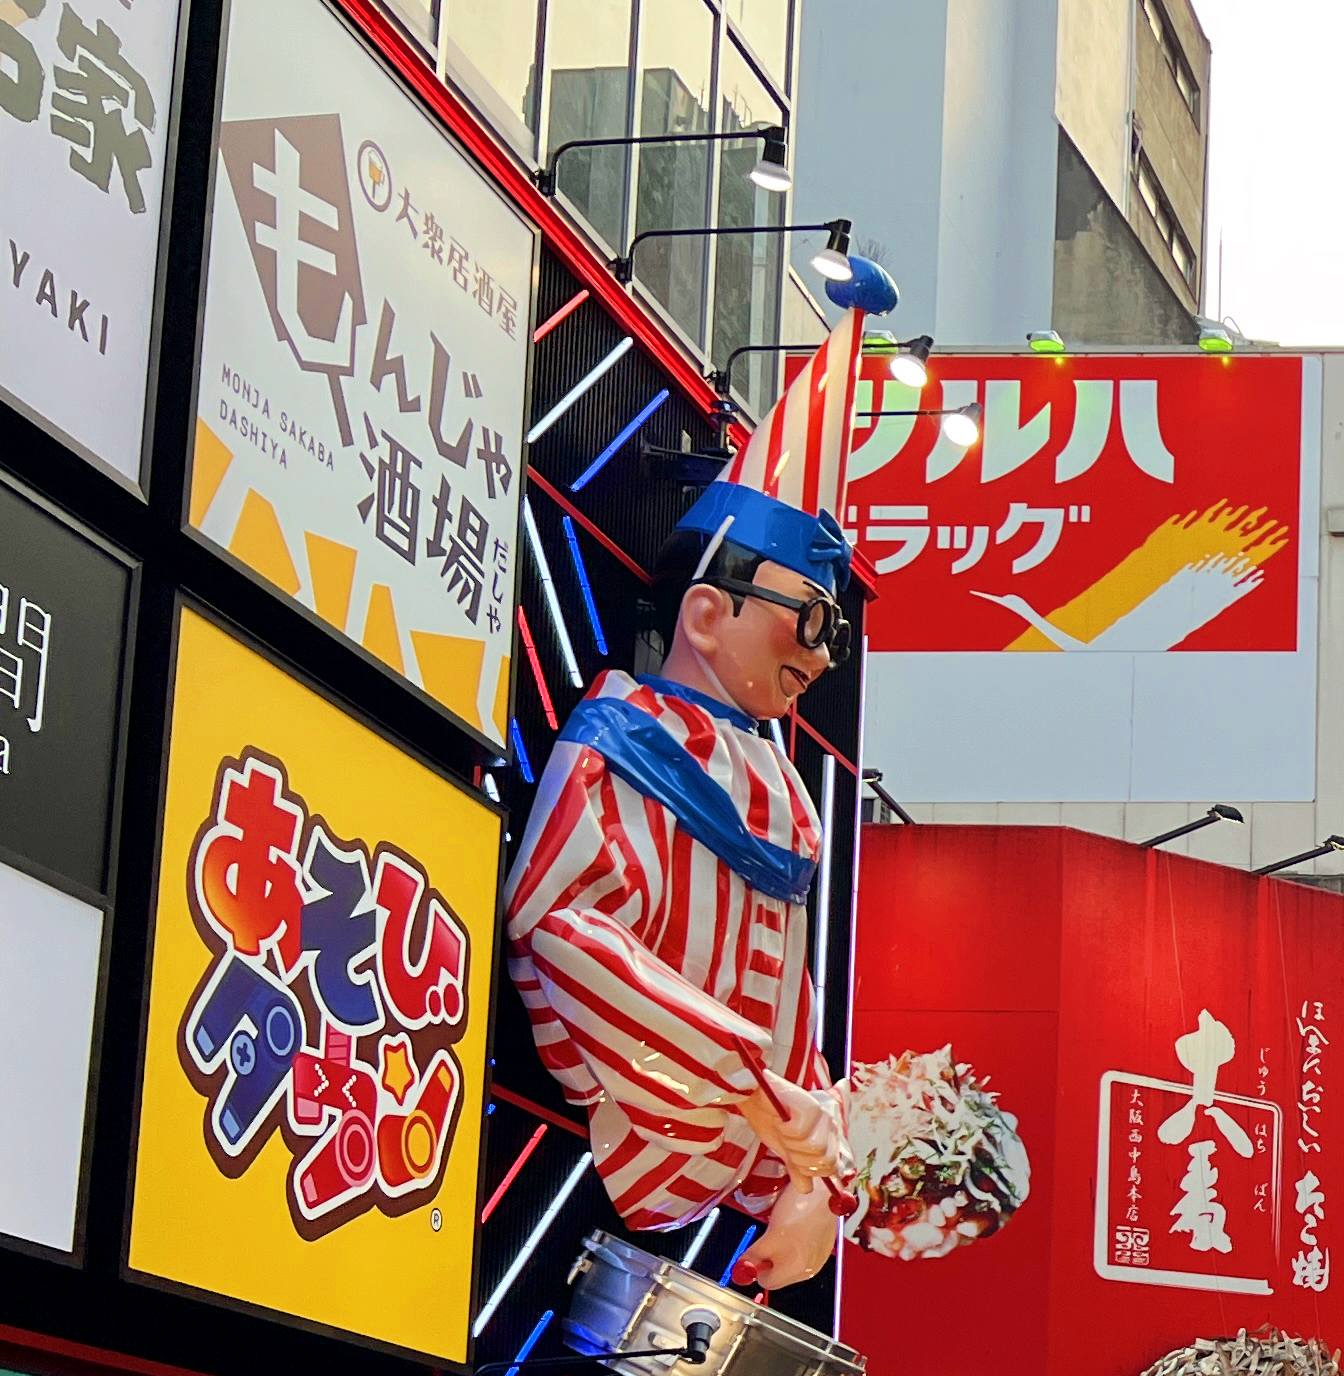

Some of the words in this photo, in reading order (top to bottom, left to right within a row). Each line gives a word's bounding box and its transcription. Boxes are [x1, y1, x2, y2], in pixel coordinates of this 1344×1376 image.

[252, 128, 513, 500] もんじゃ
[396, 186, 518, 342] 大衆居酒屋
[219, 398, 288, 470] DASHIYA
[221, 362, 271, 419] MONJA
[279, 410, 335, 472] SAKABA
[357, 411, 489, 626] 酒場
[198, 757, 470, 1036] あそび
[1124, 1088, 1146, 1223] 大阪西中島本店
[1291, 1171, 1331, 1291] たこ焼
